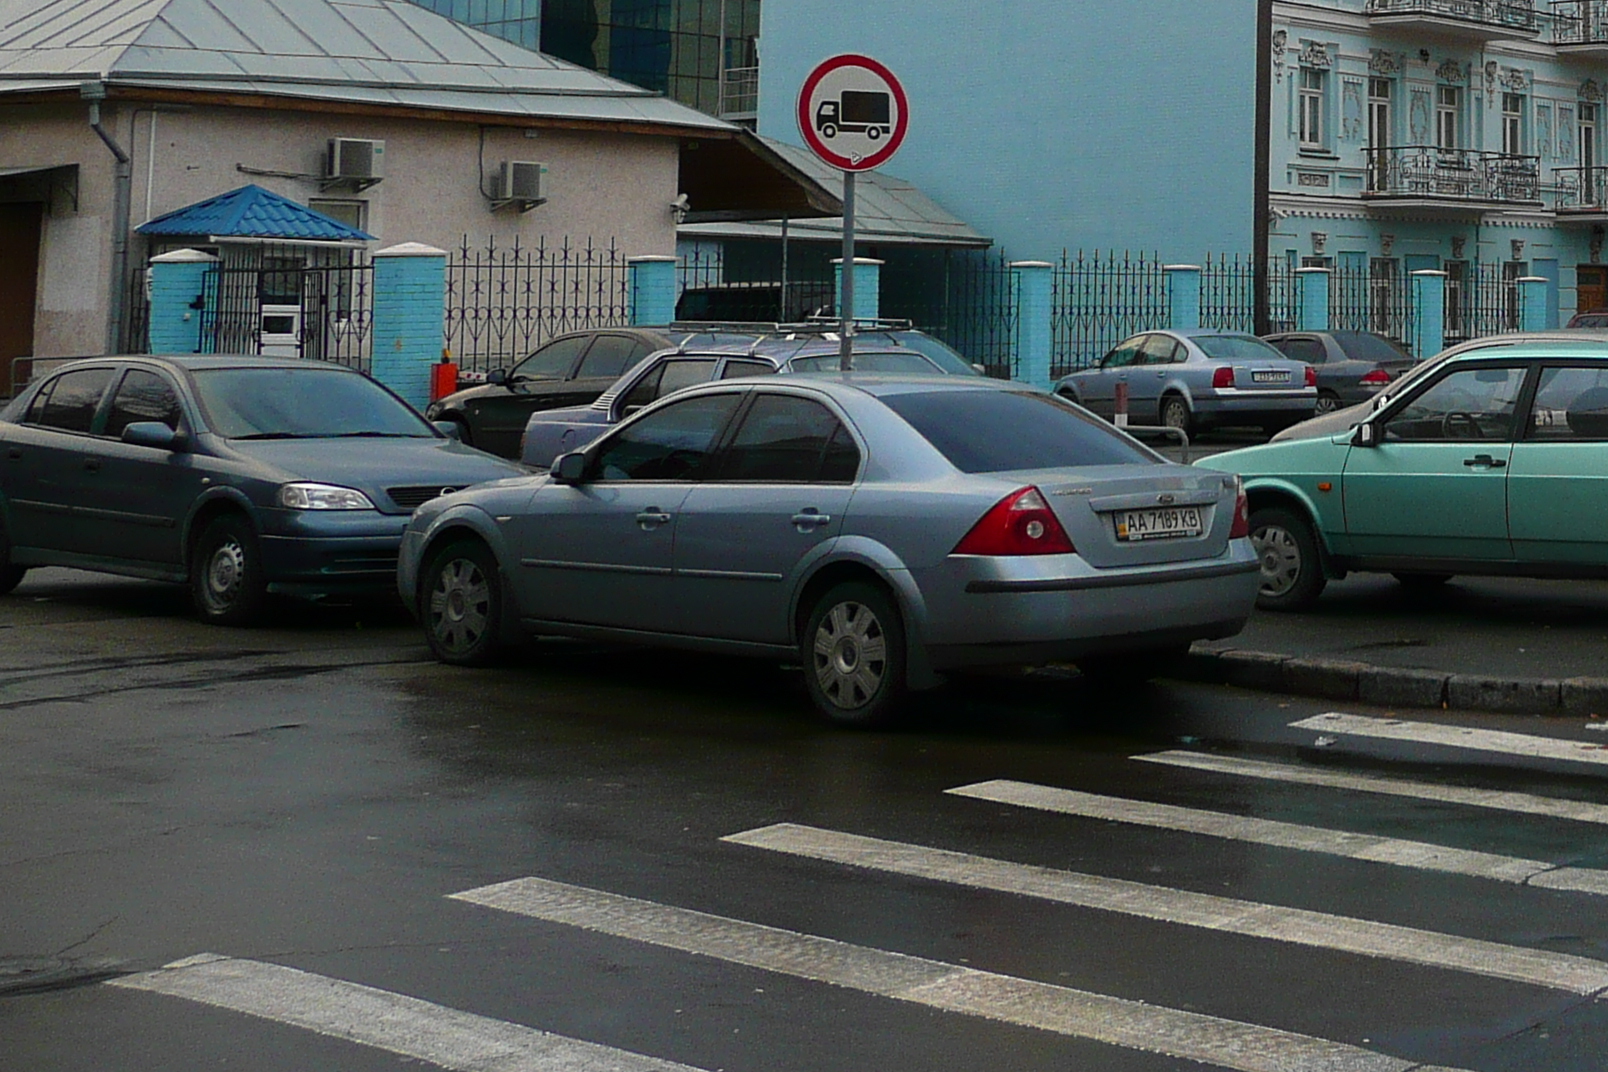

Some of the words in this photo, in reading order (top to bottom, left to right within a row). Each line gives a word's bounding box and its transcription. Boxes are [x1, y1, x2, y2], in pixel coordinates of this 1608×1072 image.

[1128, 514, 1148, 532] AA
[1150, 512, 1179, 530] 7189
[1182, 510, 1198, 528] KB
